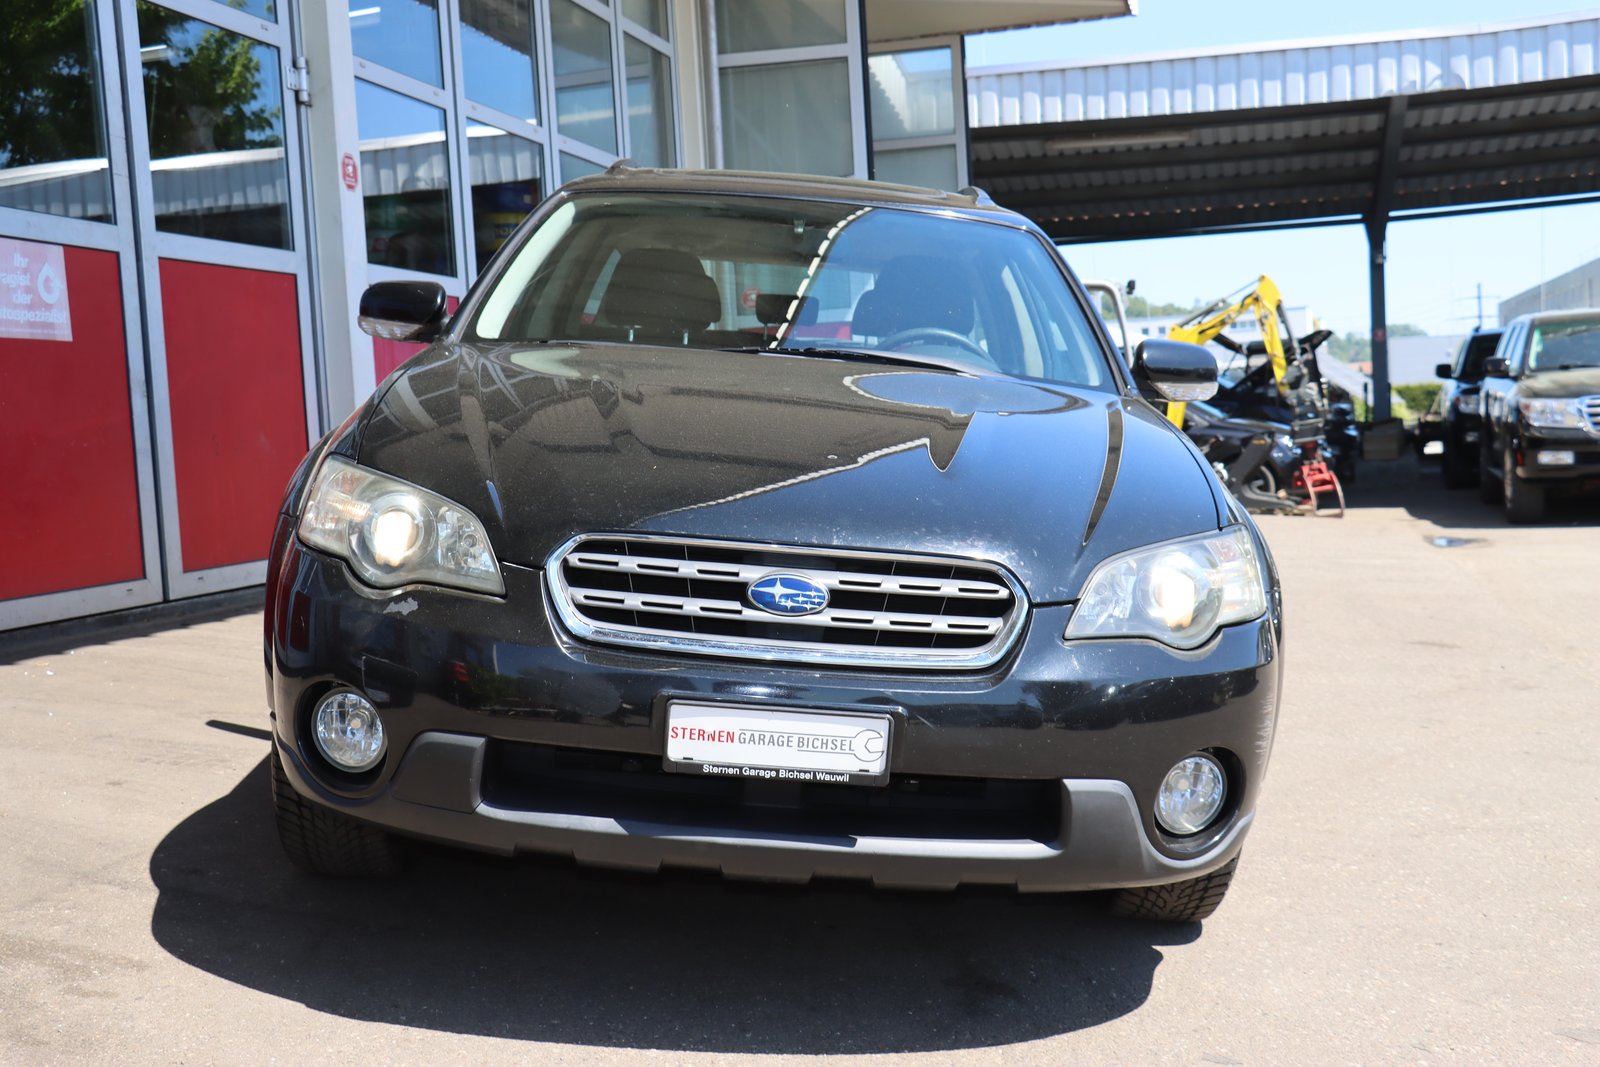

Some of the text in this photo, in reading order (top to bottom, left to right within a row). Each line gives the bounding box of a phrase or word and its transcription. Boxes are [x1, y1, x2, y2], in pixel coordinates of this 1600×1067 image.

[671, 726, 855, 752] STERNEN GARAGE BICHSEL
[702, 764, 850, 782] Sternen Garage Bichsel Wauwil
